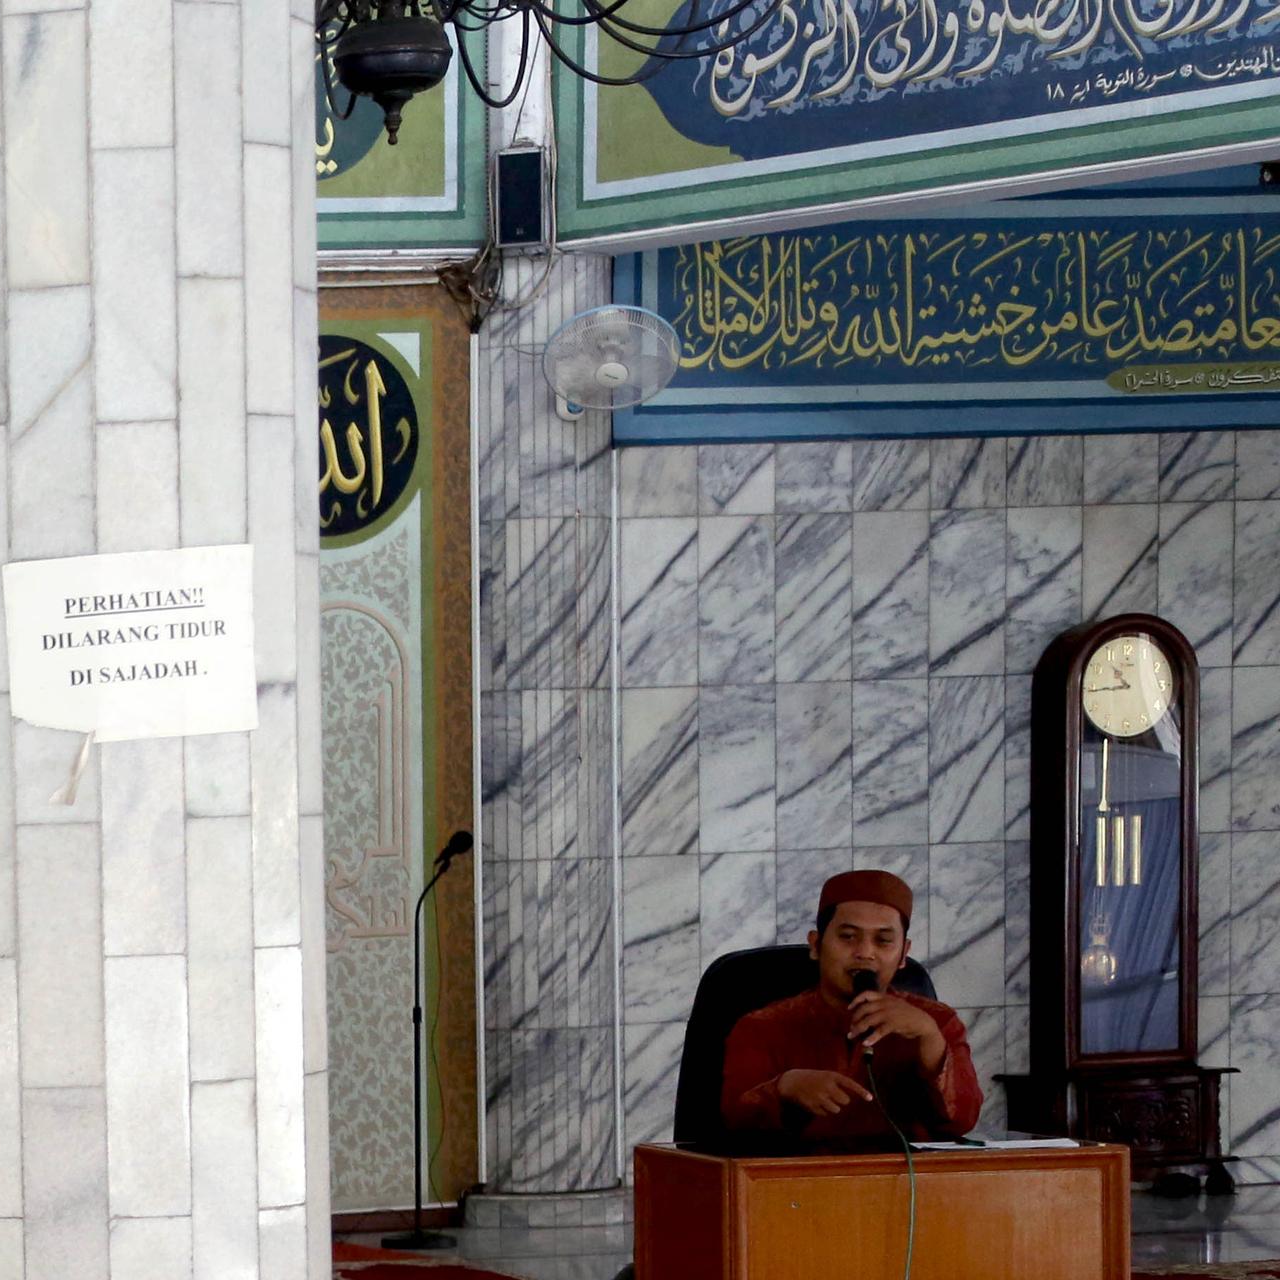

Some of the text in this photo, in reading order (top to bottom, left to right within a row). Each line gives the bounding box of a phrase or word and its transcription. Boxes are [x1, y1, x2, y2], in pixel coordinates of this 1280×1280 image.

[64, 587, 205, 617] PERHATIAN!!
[42, 619, 227, 651] DILARANG TIDUR
[70, 668, 93, 687] DI
